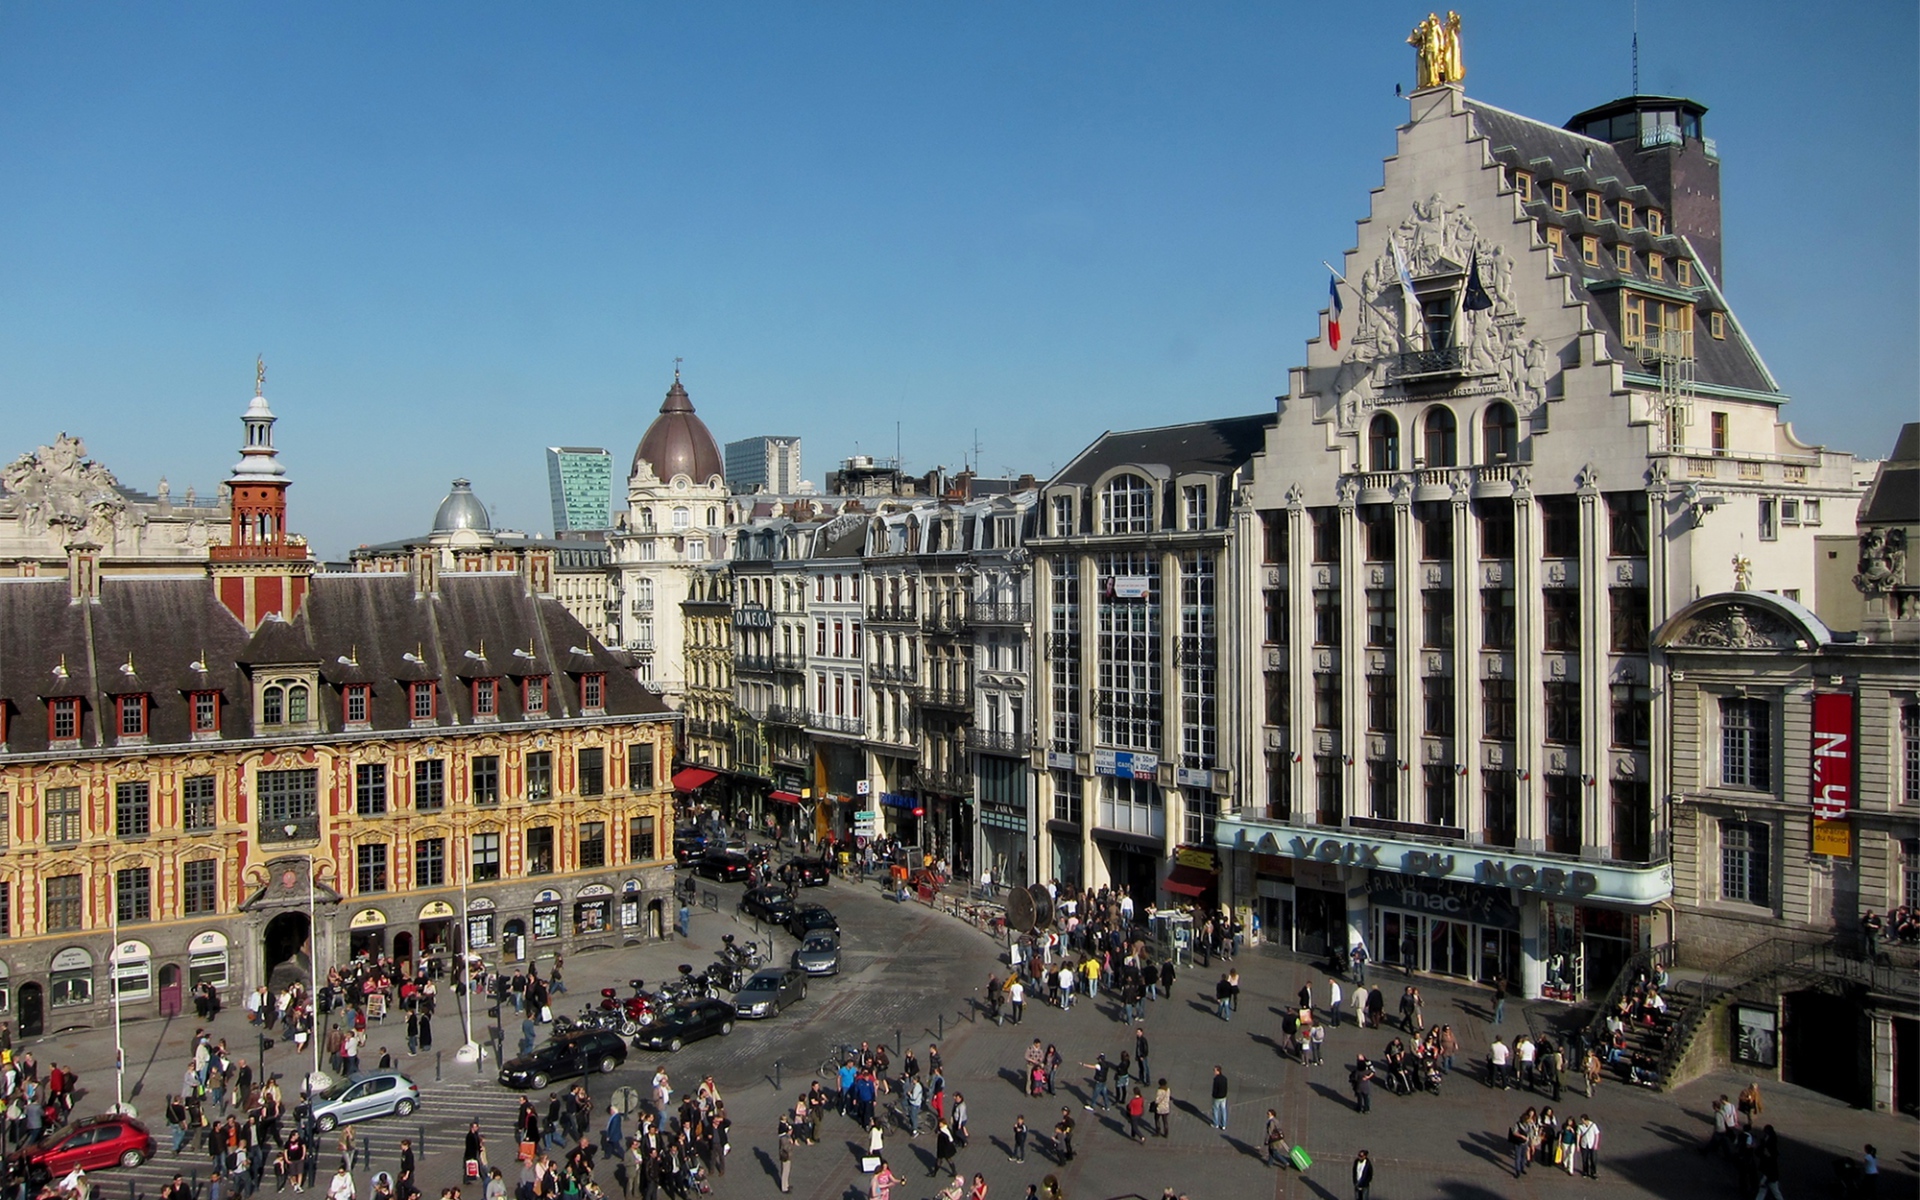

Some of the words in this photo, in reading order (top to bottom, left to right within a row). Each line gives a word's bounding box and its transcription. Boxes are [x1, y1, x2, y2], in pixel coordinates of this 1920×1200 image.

[737, 611, 771, 627] OMEGA
[995, 804, 1013, 814] ZARA
[1828, 835, 1847, 844] Nord
[1236, 828, 1281, 852] LA
[1291, 835, 1382, 866] VOIX
[1406, 850, 1455, 875] DU
[1478, 859, 1598, 894] NORD
[1437, 879, 1495, 912] PLACE
[535, 905, 558, 913] voyages
[581, 900, 605, 909] voyages
[468, 914, 493, 922] voyages
